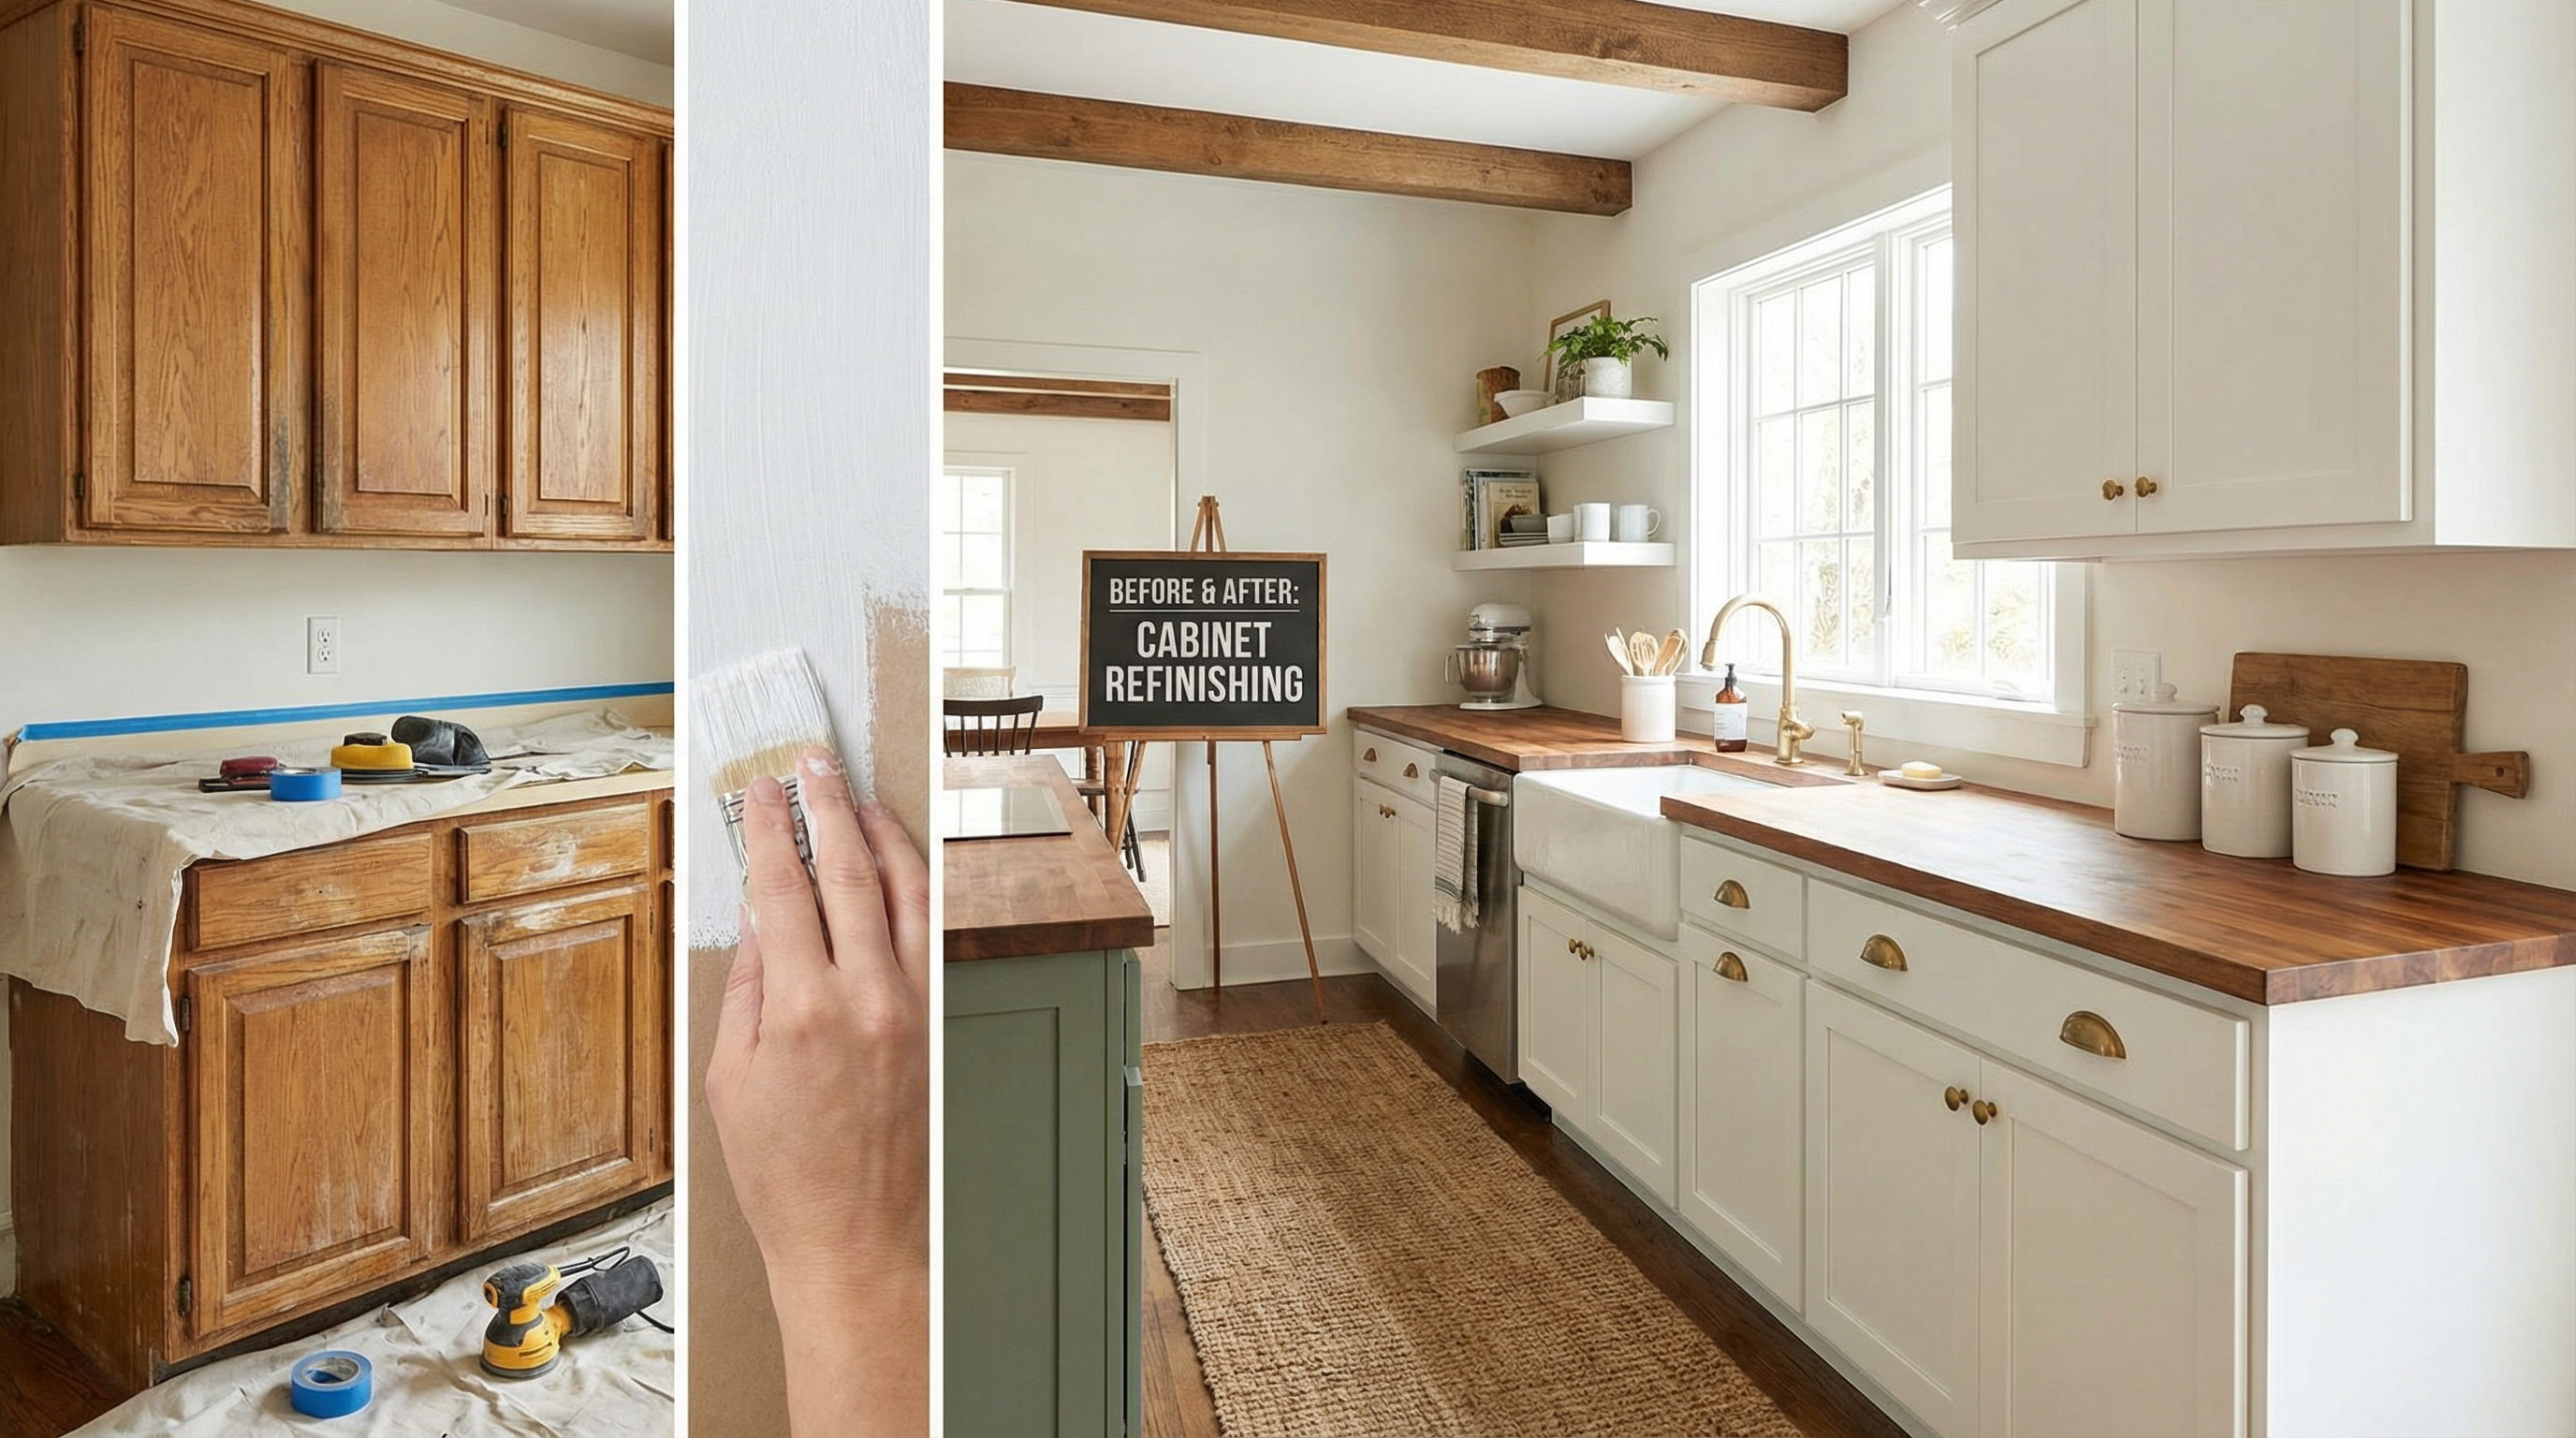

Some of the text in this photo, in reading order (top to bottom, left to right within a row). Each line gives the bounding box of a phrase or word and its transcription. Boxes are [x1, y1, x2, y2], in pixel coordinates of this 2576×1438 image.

[1109, 578, 1299, 605] BEFORE & AFTER:
[1136, 621, 1272, 658] CABINET
[1105, 665, 1303, 702] REFINISHING
